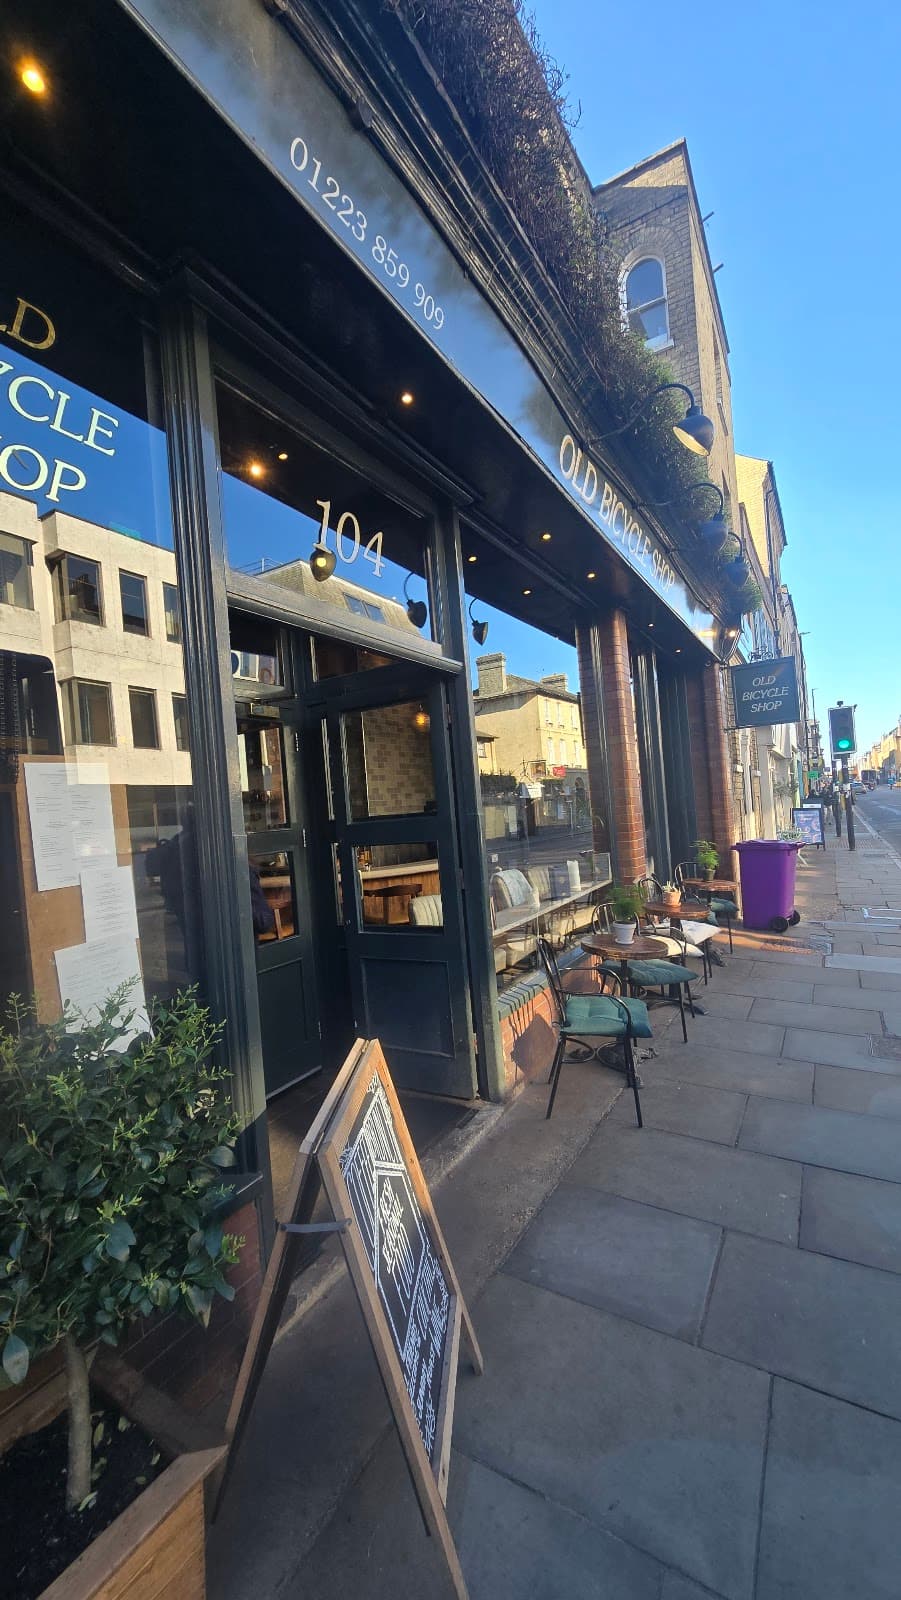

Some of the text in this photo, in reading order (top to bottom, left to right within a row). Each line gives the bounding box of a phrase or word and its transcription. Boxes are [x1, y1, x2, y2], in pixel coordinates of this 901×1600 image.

[290, 137, 445, 330] 01223 859 909
[0, 436, 87, 502] OP
[312, 499, 386, 578] 104
[559, 434, 676, 593] OLD BICYCLE SHOP
[742, 686, 790, 701] BICYCLE
[750, 700, 783, 713] SHOP
[752, 675, 777, 687] OLD
